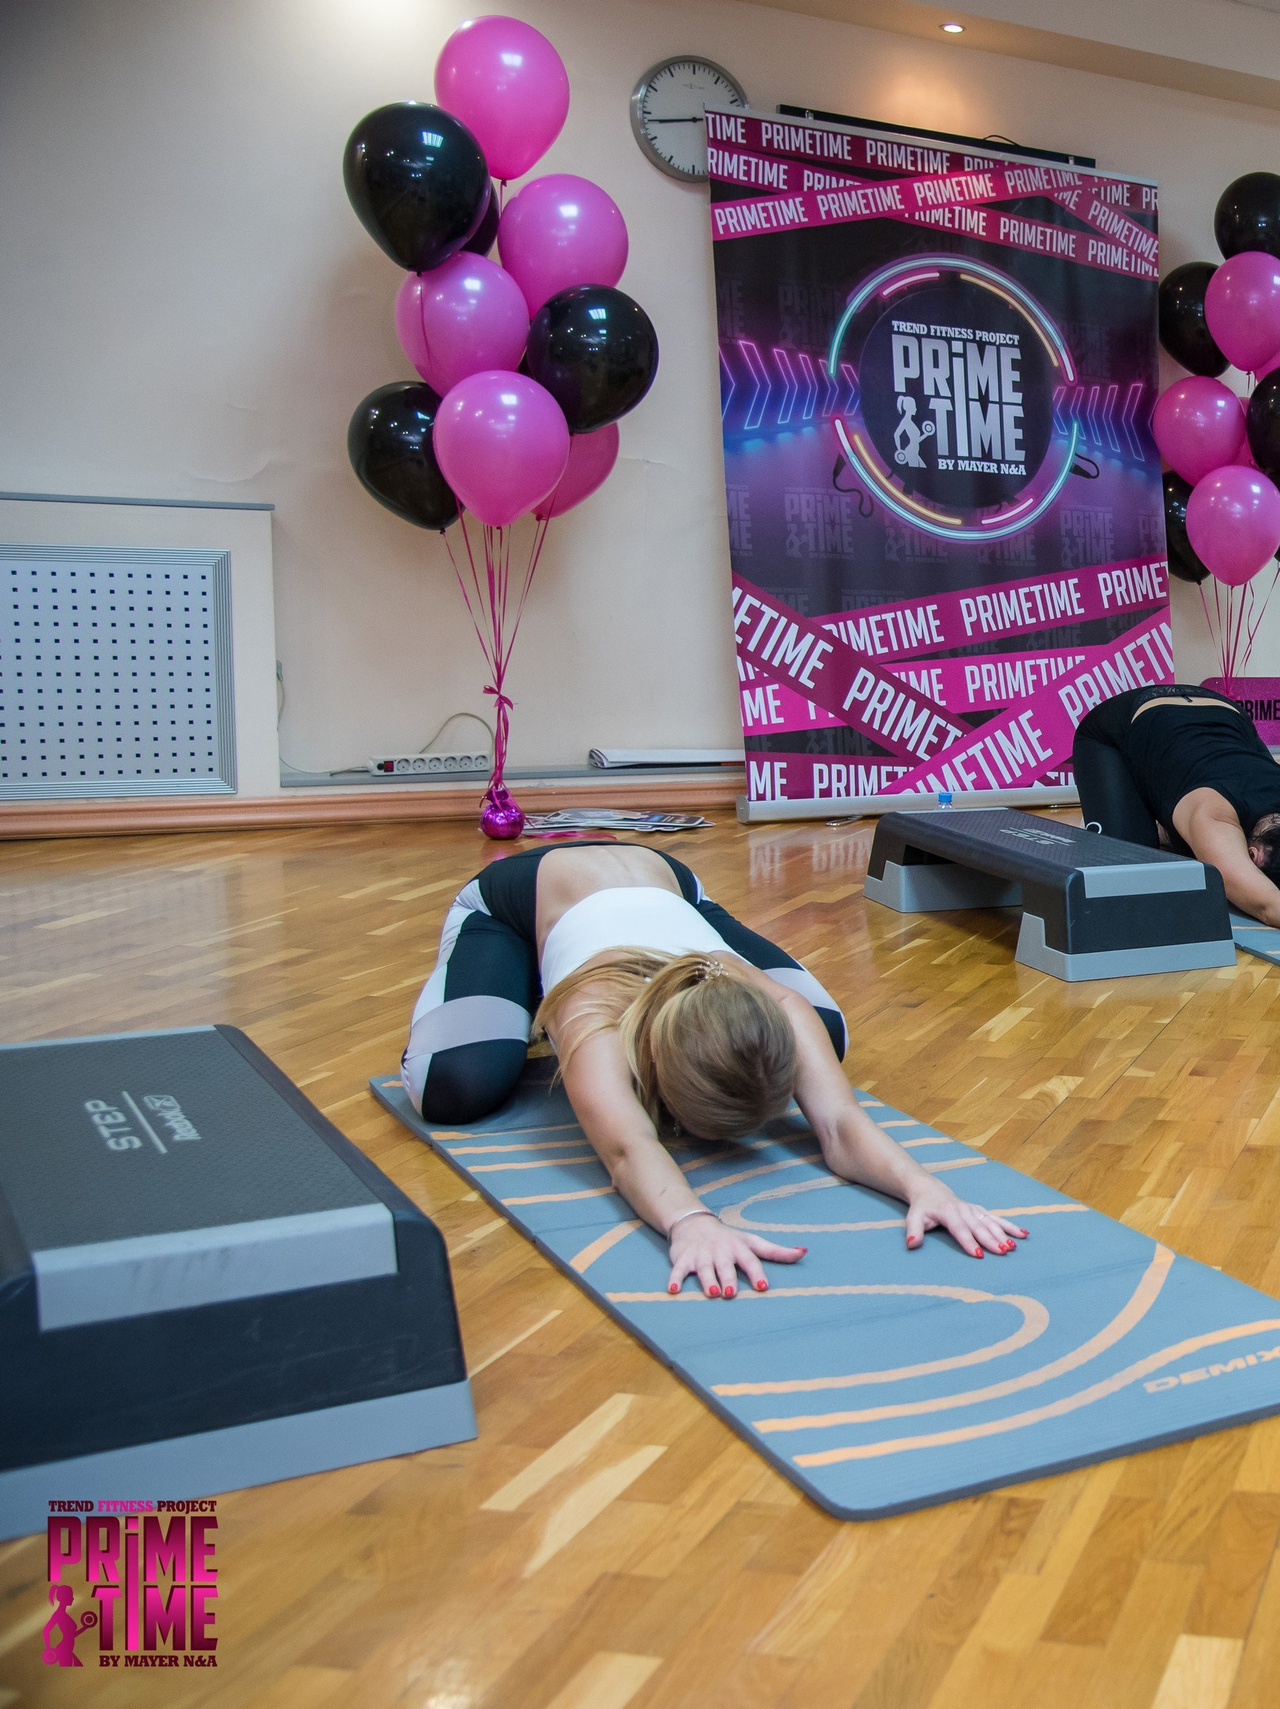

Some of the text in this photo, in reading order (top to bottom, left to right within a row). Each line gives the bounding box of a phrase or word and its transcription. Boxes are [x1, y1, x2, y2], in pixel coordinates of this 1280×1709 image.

[761, 122, 852, 161] PRIMETIME
[866, 139, 950, 175] PRIMETIME
[714, 197, 808, 235] PRIMETIME
[816, 185, 905, 220] PRIMETIME
[913, 173, 997, 207] PRIMETIME
[904, 206, 987, 236] IMETIME
[1000, 217, 1076, 258] PRIMETIME
[1088, 200, 1159, 262] PRIMETIME
[892, 320, 1020, 345] TREND FITNESS PROJECT
[929, 397, 1026, 461] TIME
[938, 459, 1027, 475] BY MAYER N&A
[960, 578, 1085, 637] PRIMETIME
[964, 655, 1086, 703] PRIMETI
[842, 667, 966, 761] PRIMET
[900, 709, 1053, 794] METIME
[84, 1099, 143, 1151] STEP
